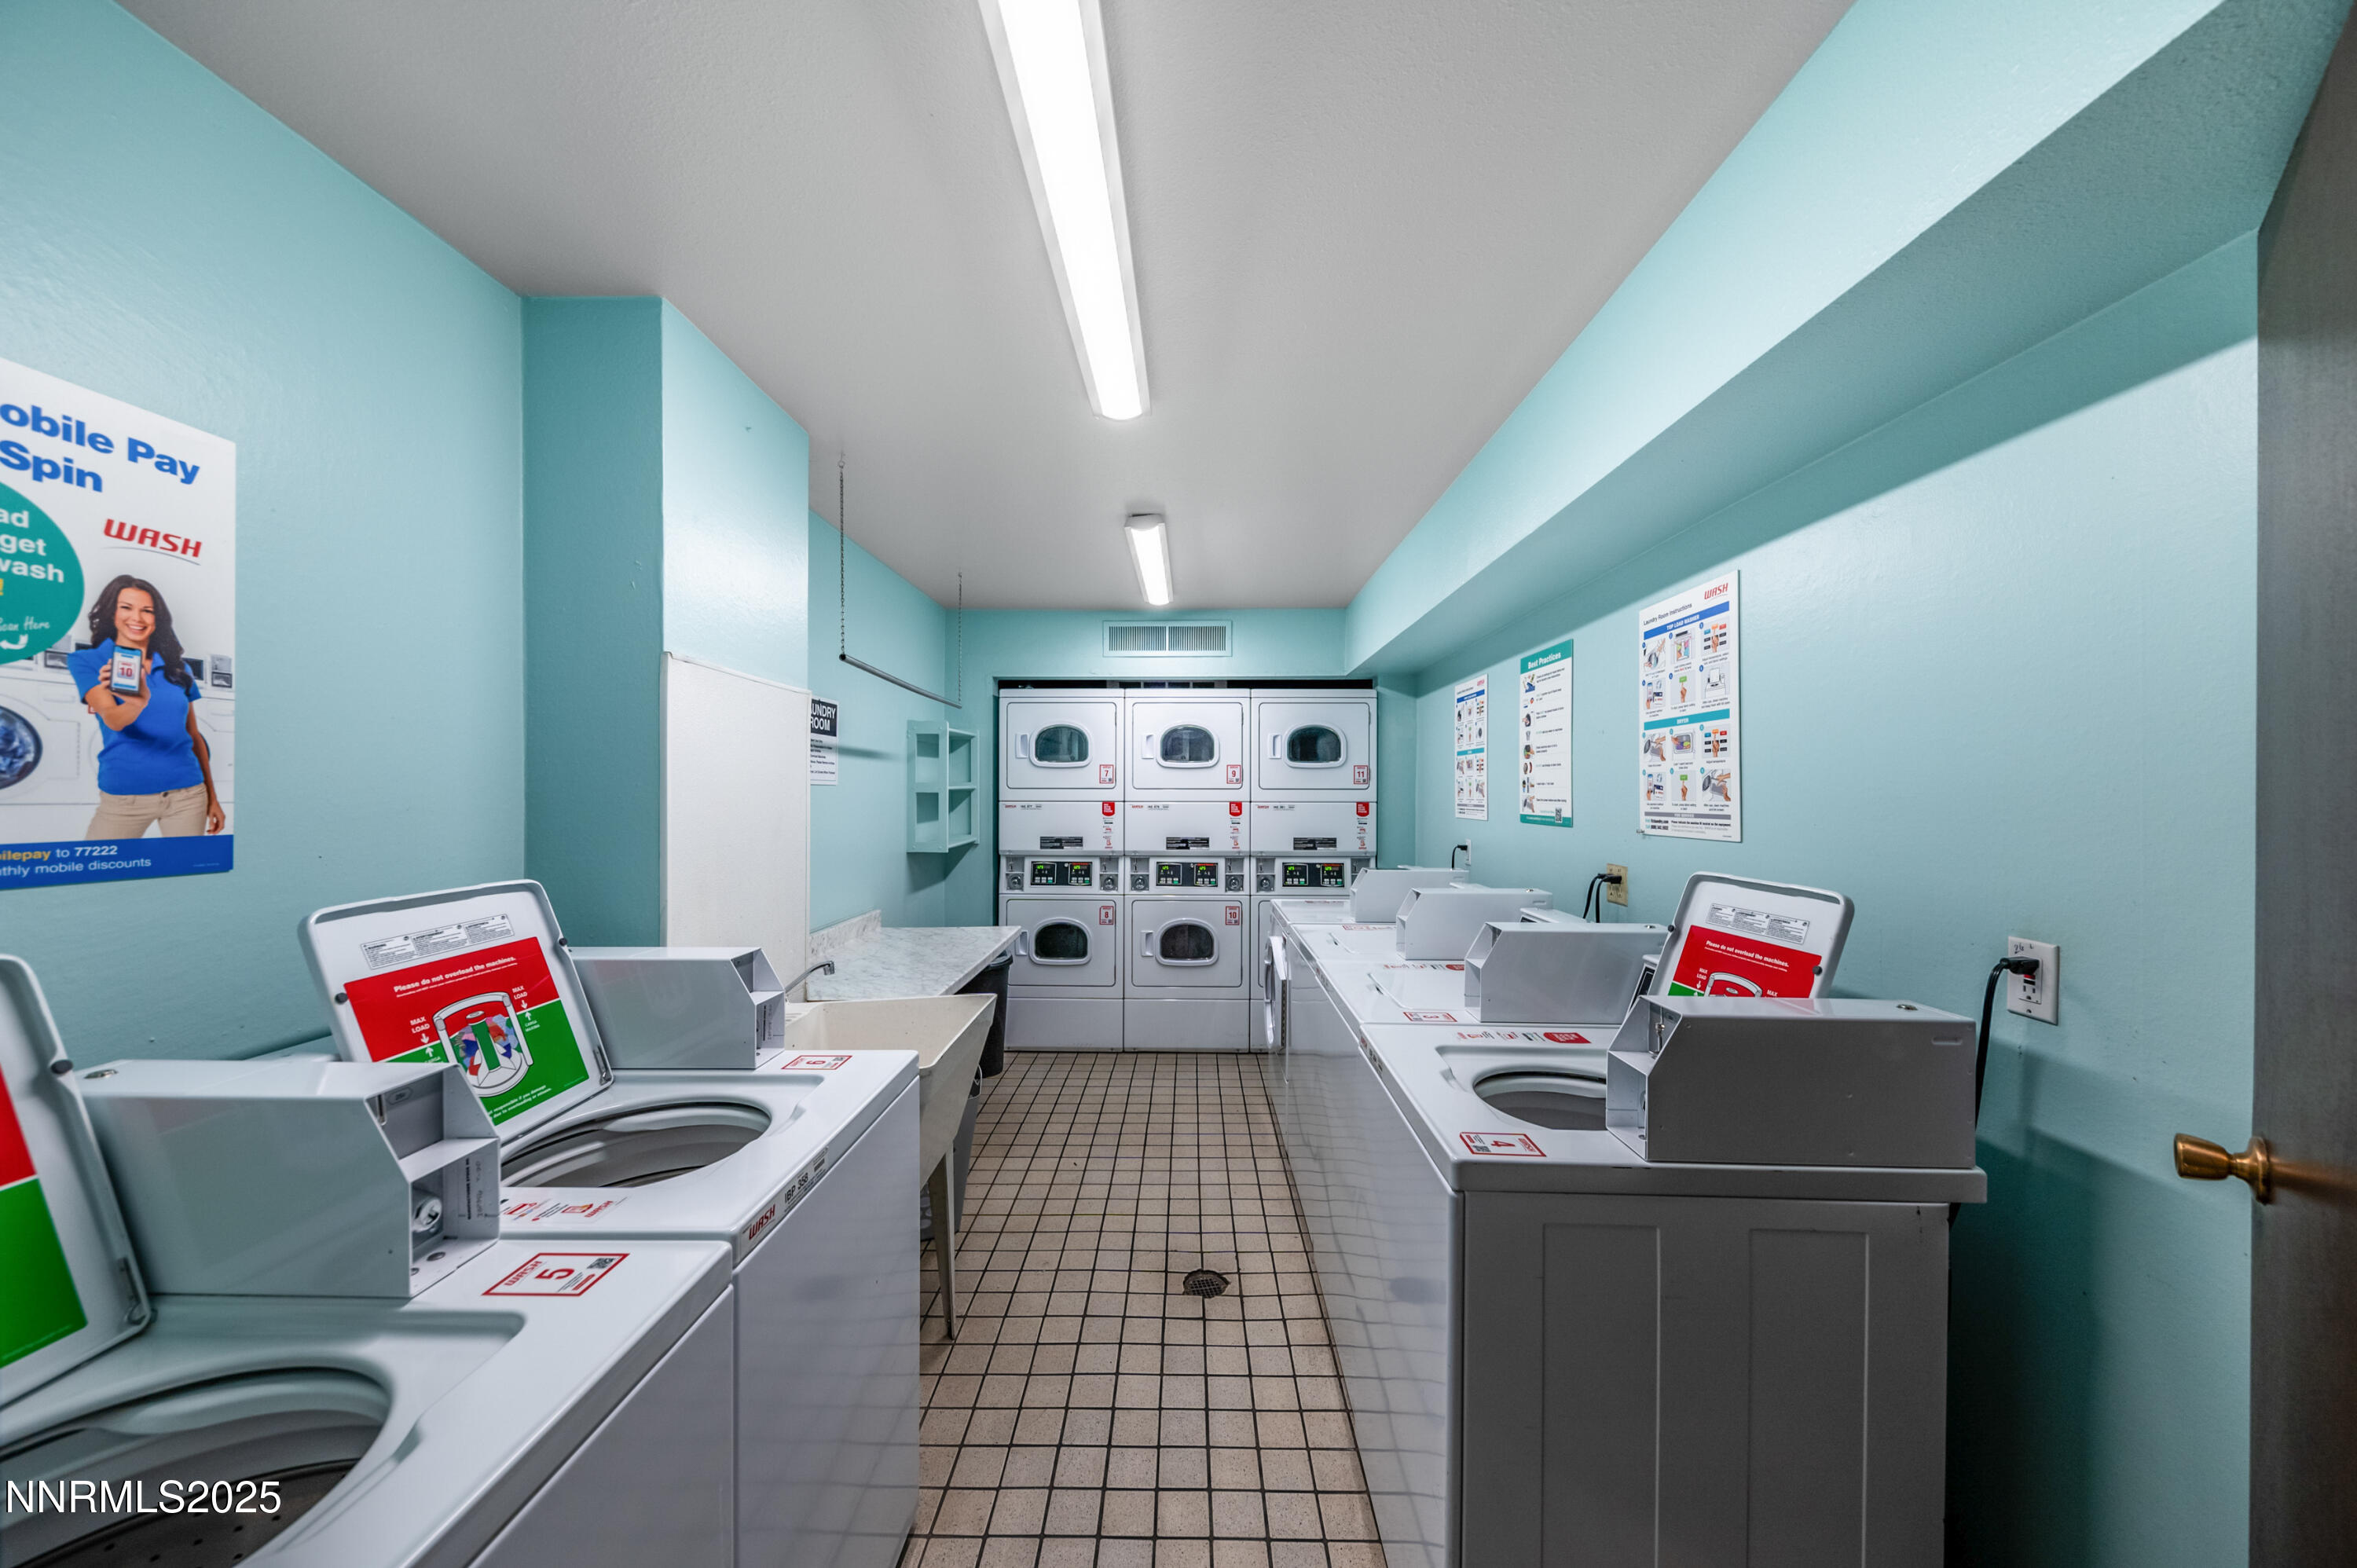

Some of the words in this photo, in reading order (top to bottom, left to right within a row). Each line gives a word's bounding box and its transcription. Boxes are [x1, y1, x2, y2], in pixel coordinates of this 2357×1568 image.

[0, 440, 103, 493] Spin
[127, 437, 200, 485] Pay
[0, 533, 46, 556] get
[103, 518, 202, 559] WASH
[1704, 583, 1728, 599] WASH
[1527, 659, 1538, 669] Best
[1538, 652, 1561, 666] Practices
[119, 667, 133, 677] 10
[811, 703, 836, 719] UNDRY
[811, 716, 830, 731] ROOM
[0, 849, 51, 862] ilepay
[56, 849, 69, 858] to
[75, 845, 118, 856] 77222
[0, 865, 31, 877] thly
[35, 861, 84, 874] mobile
[88, 857, 152, 871] discounts
[1706, 940, 1721, 949] Please
[1735, 948, 1755, 958] overload
[1764, 956, 1789, 968] machines.
[394, 981, 420, 992] Please
[431, 975, 444, 984] not
[445, 966, 474, 979] overload
[474, 963, 486, 972] the
[486, 956, 516, 968] machines.
[511, 985, 525, 994] MAX
[513, 991, 528, 1000] LOAD
[409, 1017, 427, 1026] MAX
[411, 1024, 431, 1034] LOAD
[784, 1185, 796, 1203] IBP
[749, 1203, 775, 1240] WASH
[504, 1260, 543, 1286] WASH
[533, 1268, 575, 1280] 5
